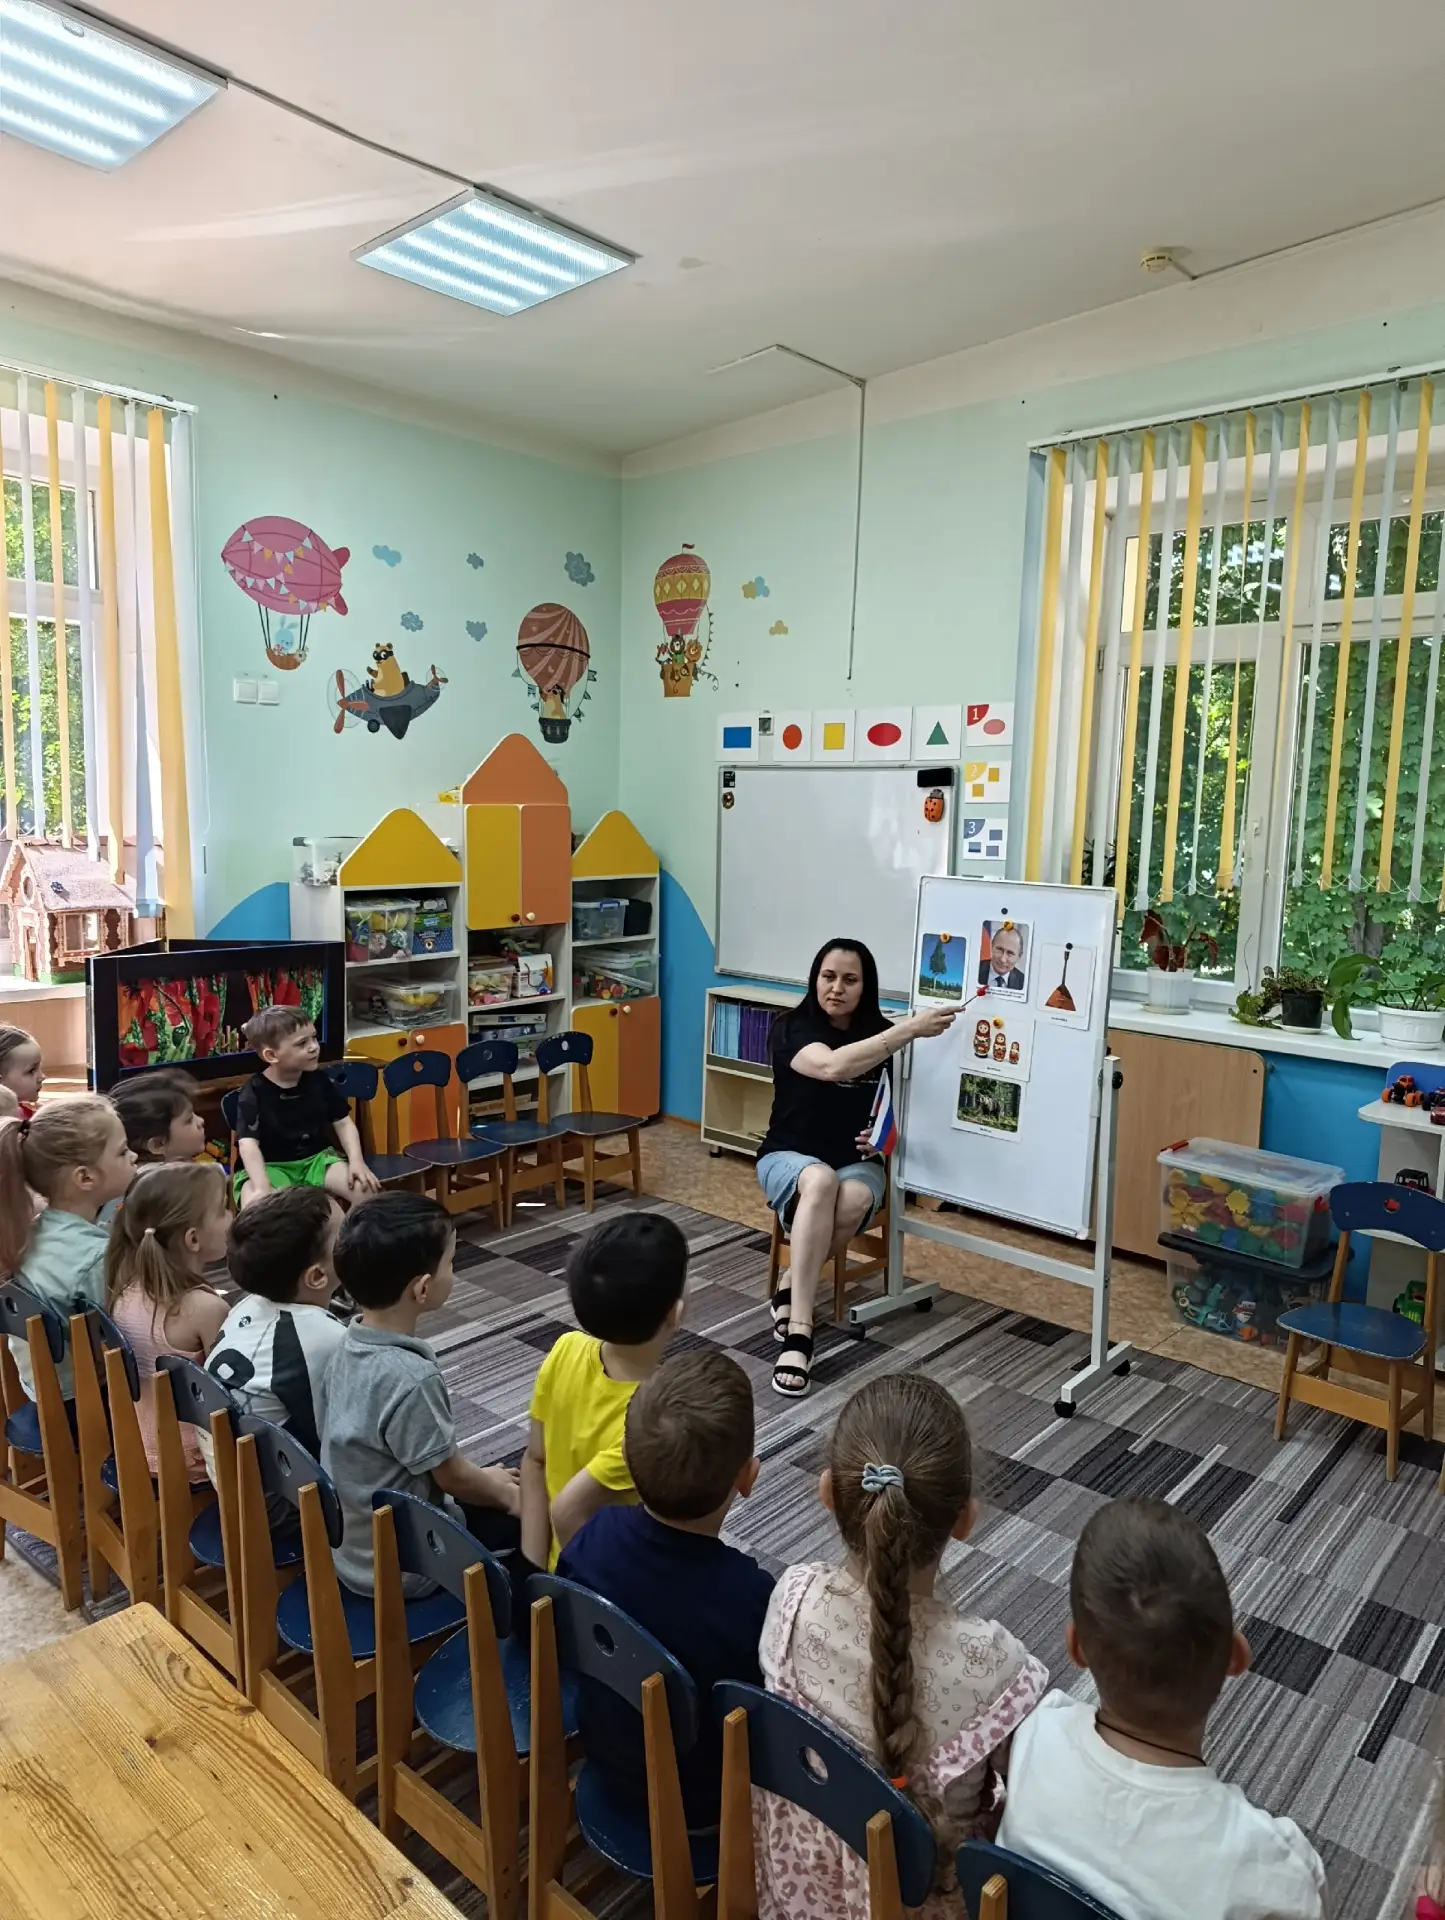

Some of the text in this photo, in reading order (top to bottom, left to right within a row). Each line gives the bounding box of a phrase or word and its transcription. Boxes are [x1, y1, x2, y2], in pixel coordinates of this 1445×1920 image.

[972, 707, 979, 720] 1
[971, 764, 977, 778] 2
[968, 821, 976, 834] 3
